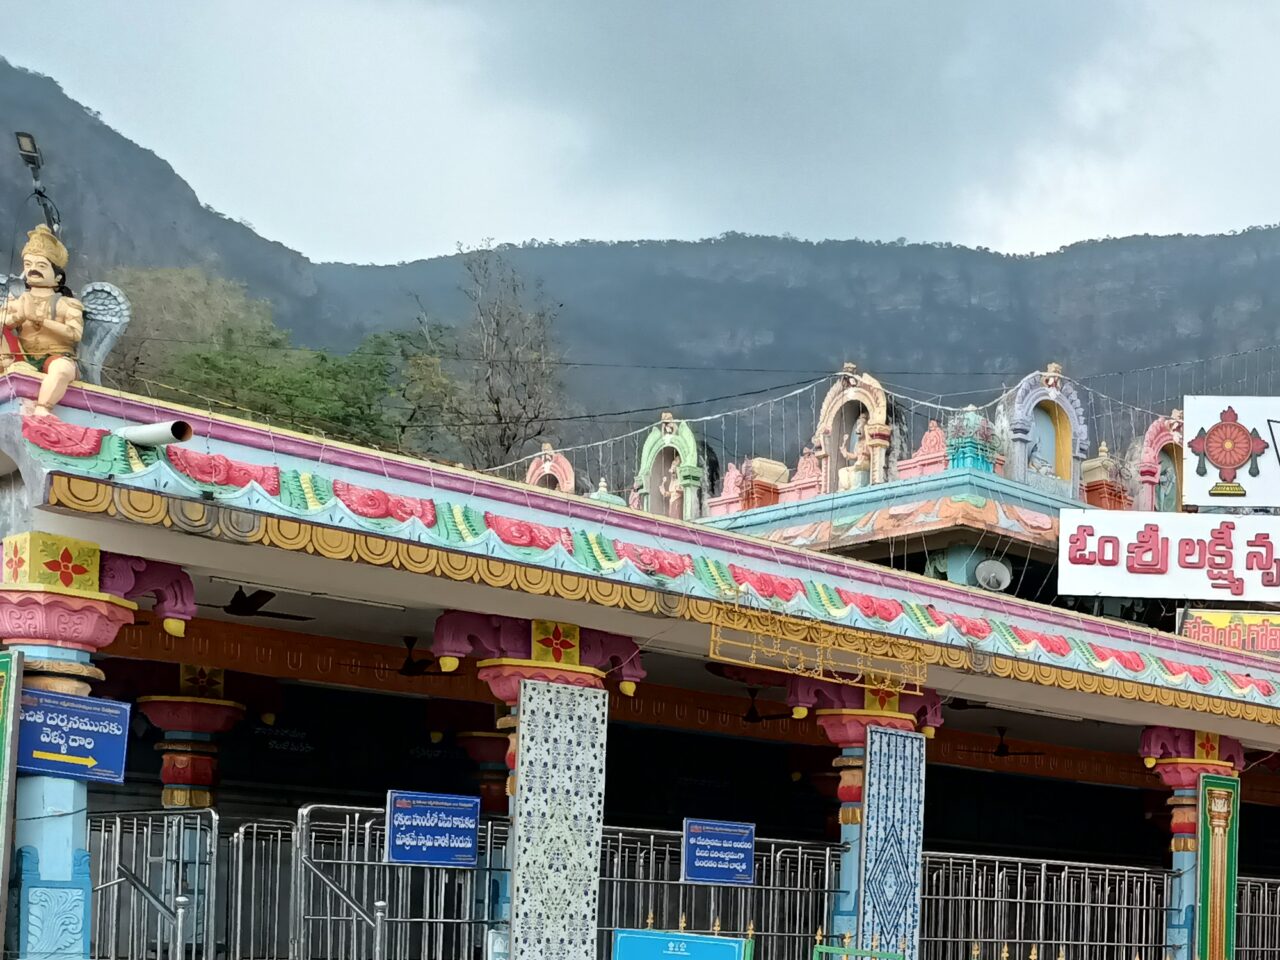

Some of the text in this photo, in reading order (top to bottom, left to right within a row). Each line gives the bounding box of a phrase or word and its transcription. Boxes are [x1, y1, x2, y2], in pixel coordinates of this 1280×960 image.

[1068, 524, 1120, 566] ఓం
[1126, 523, 1169, 575] శ్రీ
[1178, 521, 1244, 595] లక్ష్మీ
[46, 712, 123, 735] దర్శనమునకు
[68, 734, 95, 749] దారి
